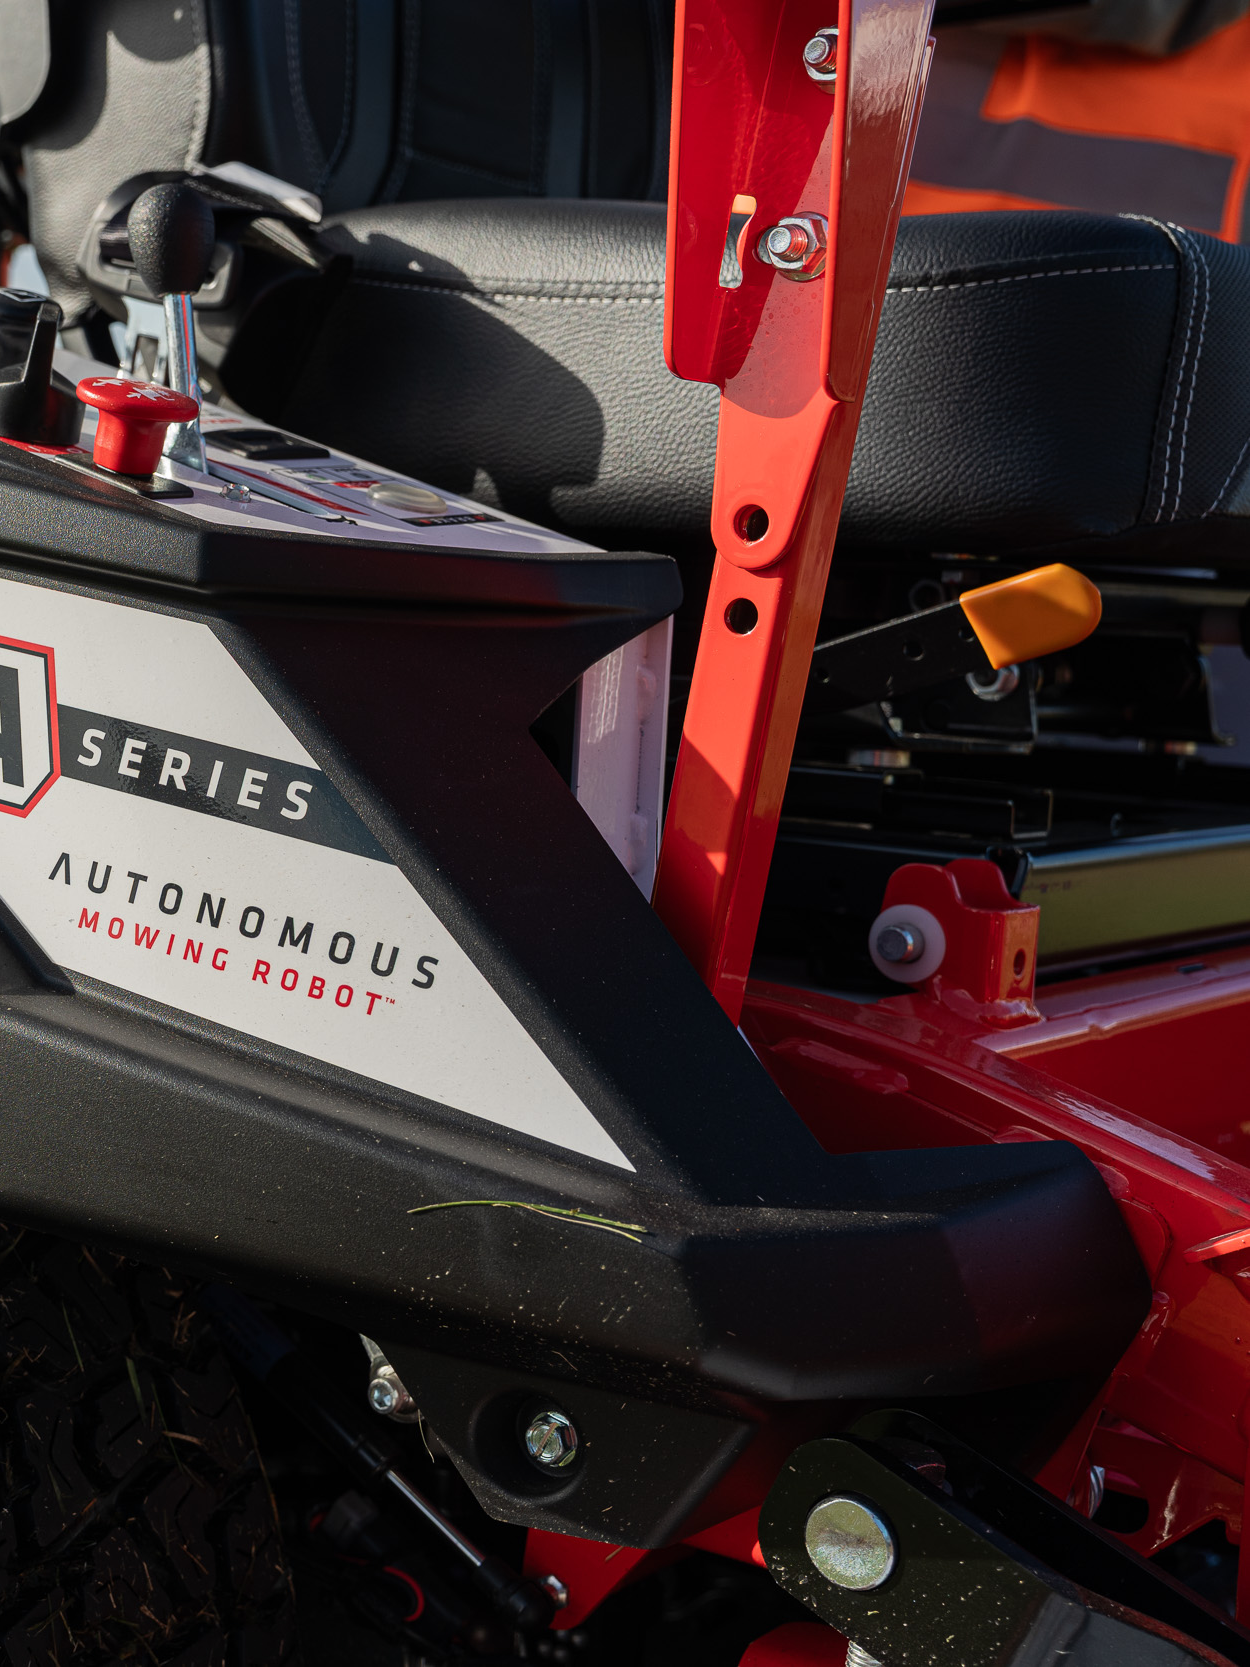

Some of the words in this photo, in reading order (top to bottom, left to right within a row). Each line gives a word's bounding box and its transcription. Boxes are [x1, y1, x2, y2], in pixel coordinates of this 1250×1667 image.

[77, 728, 313, 820] SERIES
[48, 852, 440, 990] AUTONOMOUS
[77, 907, 229, 971] MOWING
